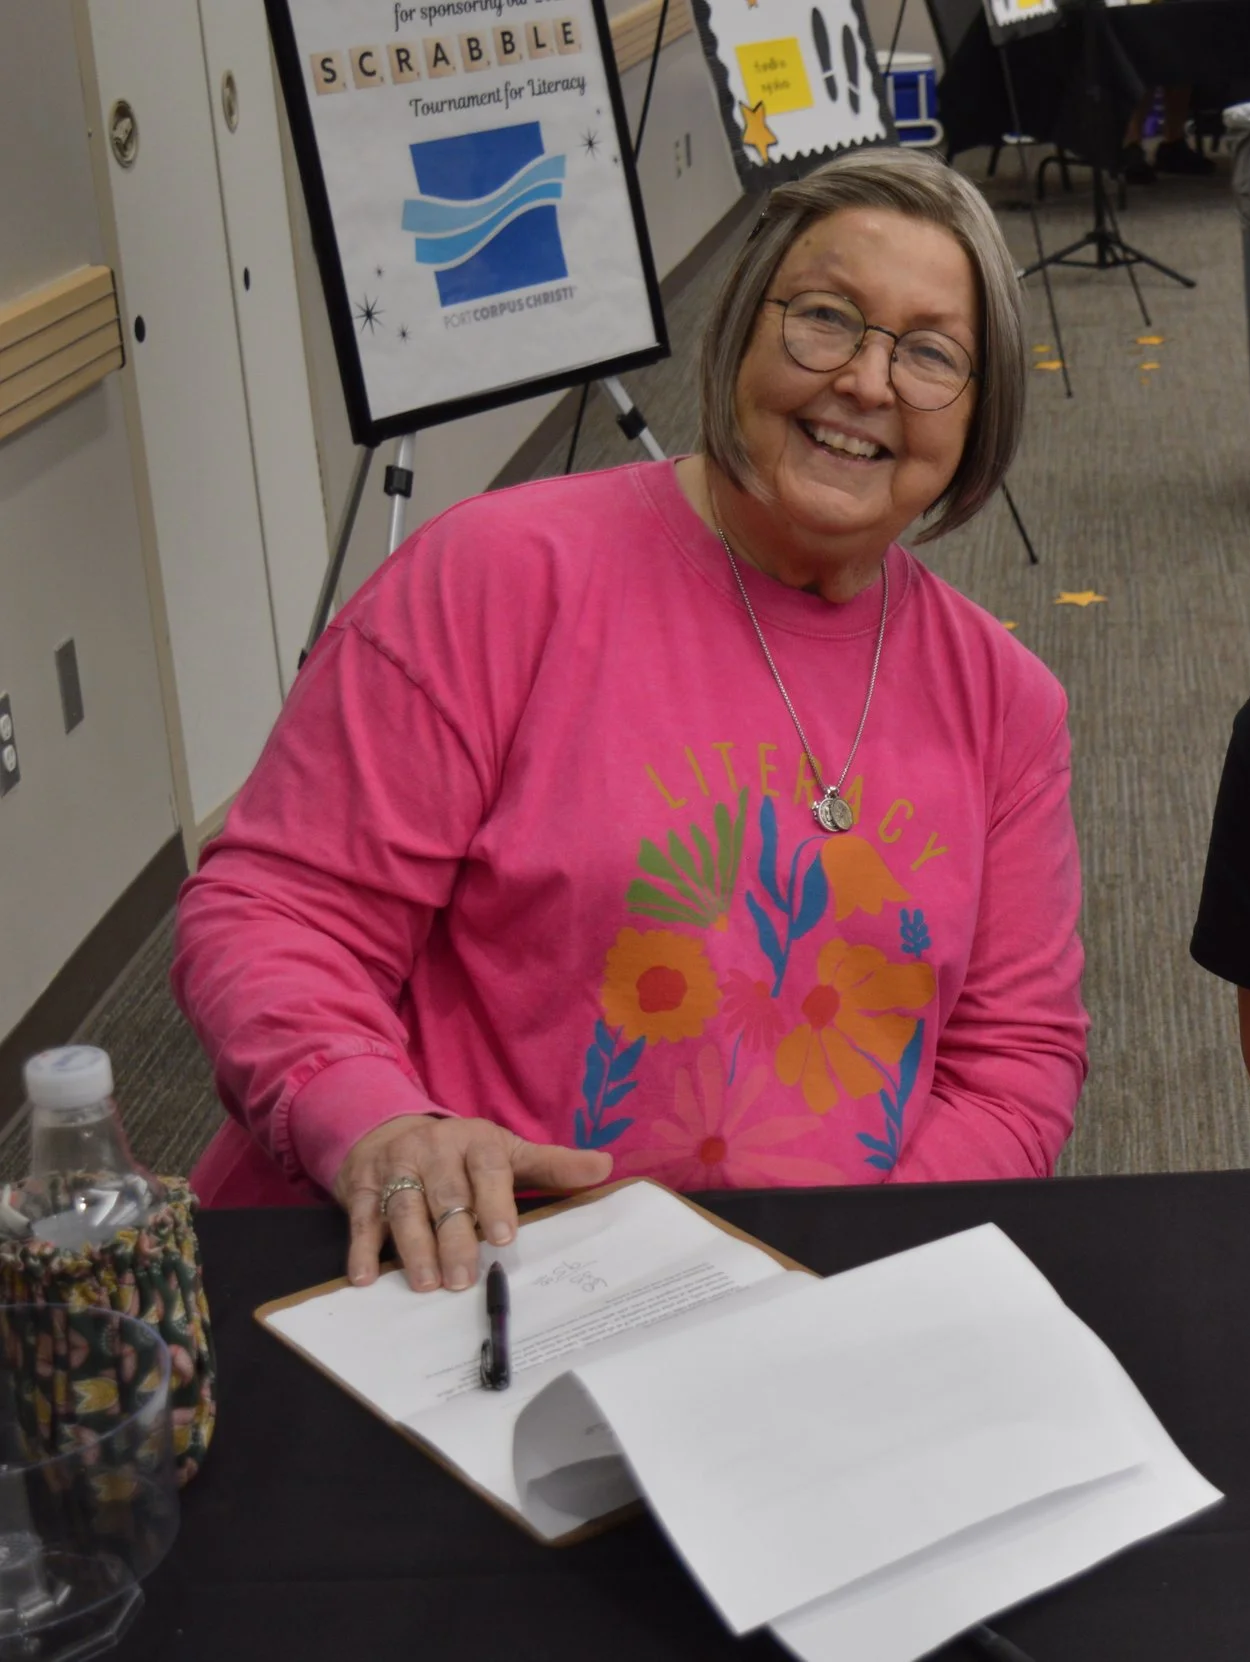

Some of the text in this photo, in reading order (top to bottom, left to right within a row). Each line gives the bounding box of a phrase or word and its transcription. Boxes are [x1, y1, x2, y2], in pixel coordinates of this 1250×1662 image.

[394, 3, 416, 32] for
[420, 0, 503, 27] sponsoring
[320, 22, 575, 84] SCRABBLE
[409, 75, 586, 117] Tournament for Literacy
[526, 286, 575, 308] CHRISTI
[645, 742, 948, 872] LITERACY
